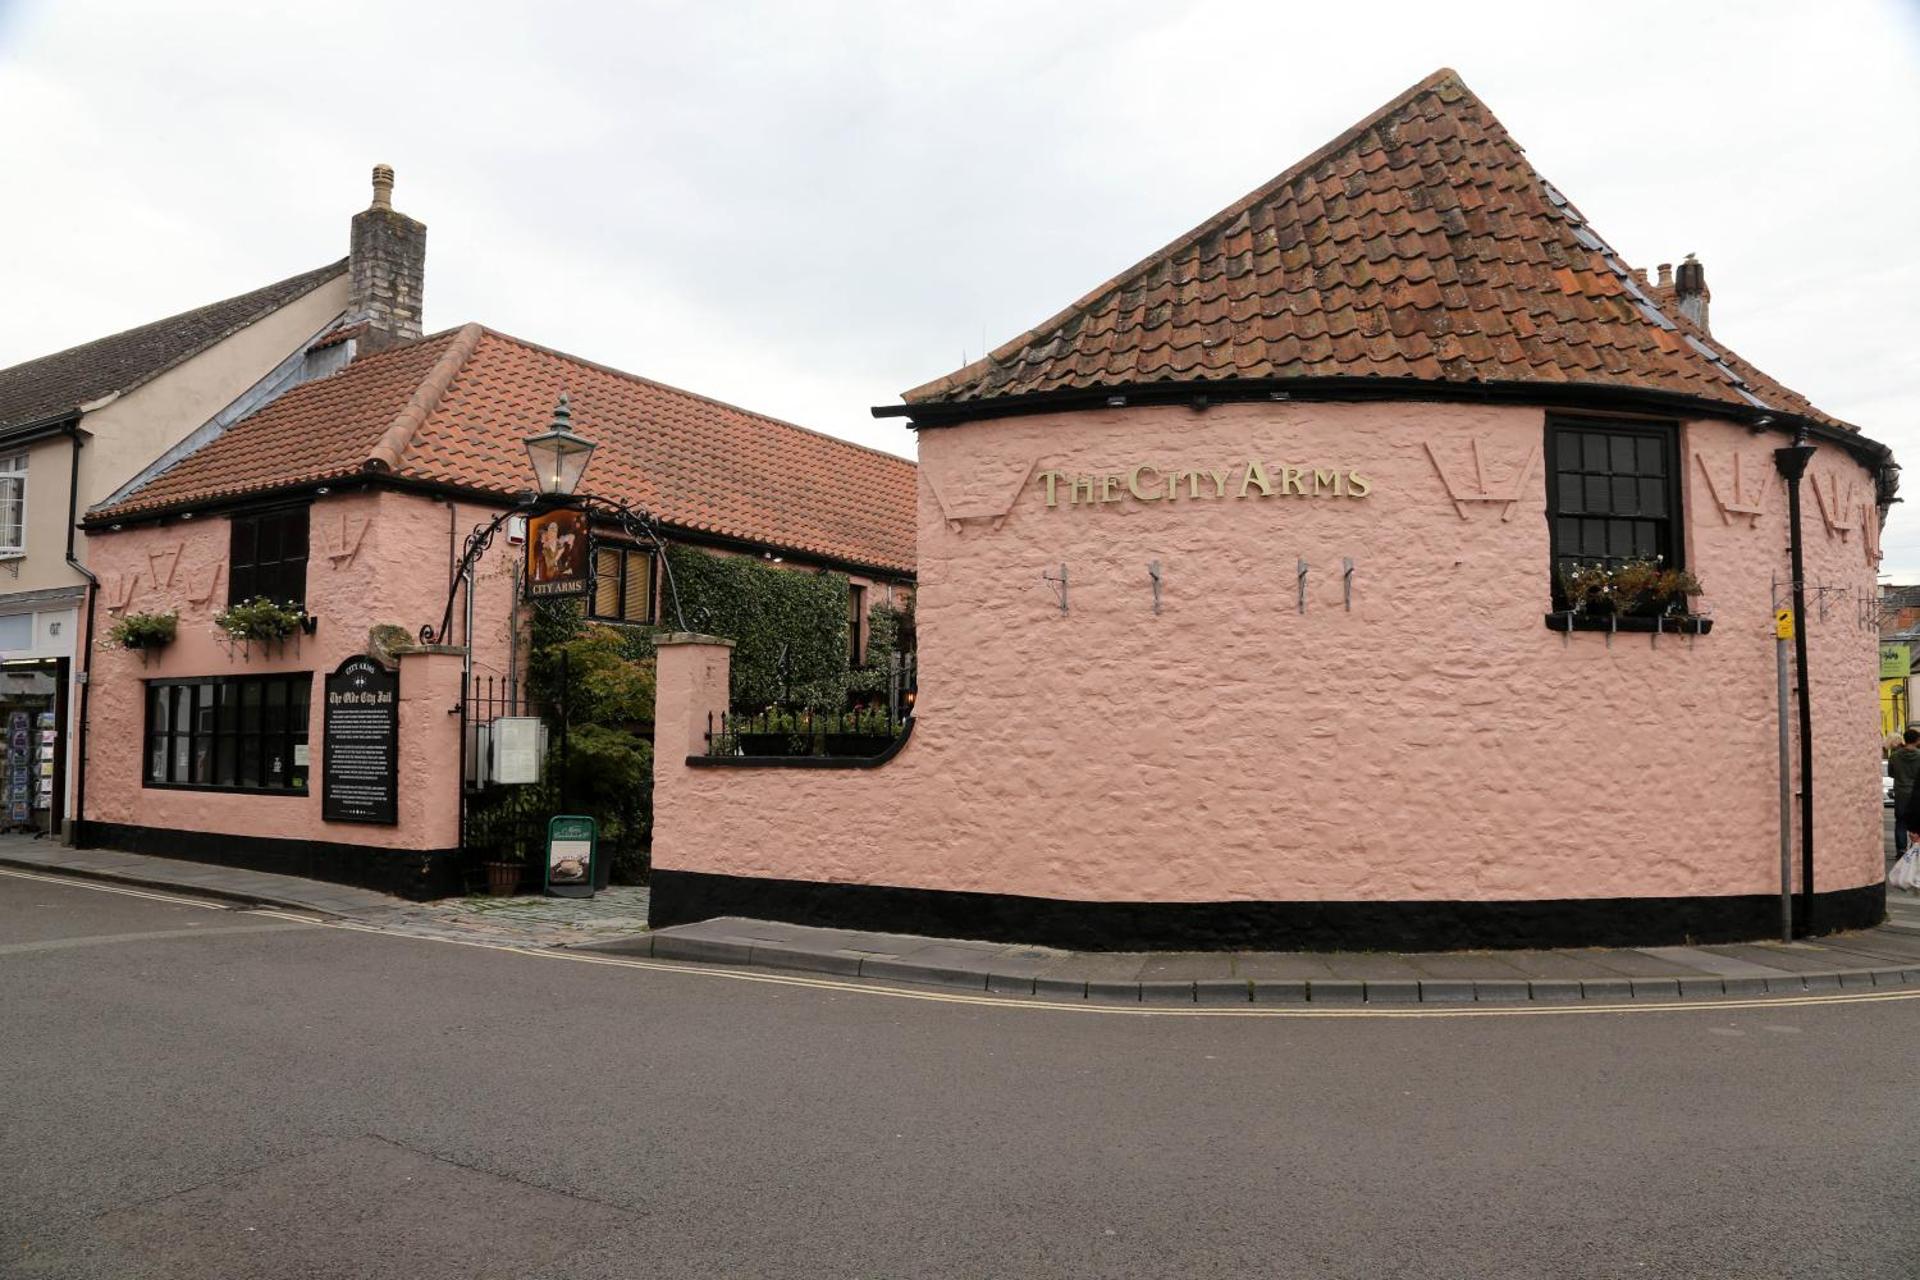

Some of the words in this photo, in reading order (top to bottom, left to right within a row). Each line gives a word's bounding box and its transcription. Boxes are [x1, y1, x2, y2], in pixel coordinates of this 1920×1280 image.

[533, 583, 552, 595] CITY
[554, 580, 582, 593] ARMS
[329, 691, 342, 707] The
[343, 691, 359, 704] Olde
[360, 691, 376, 706] City
